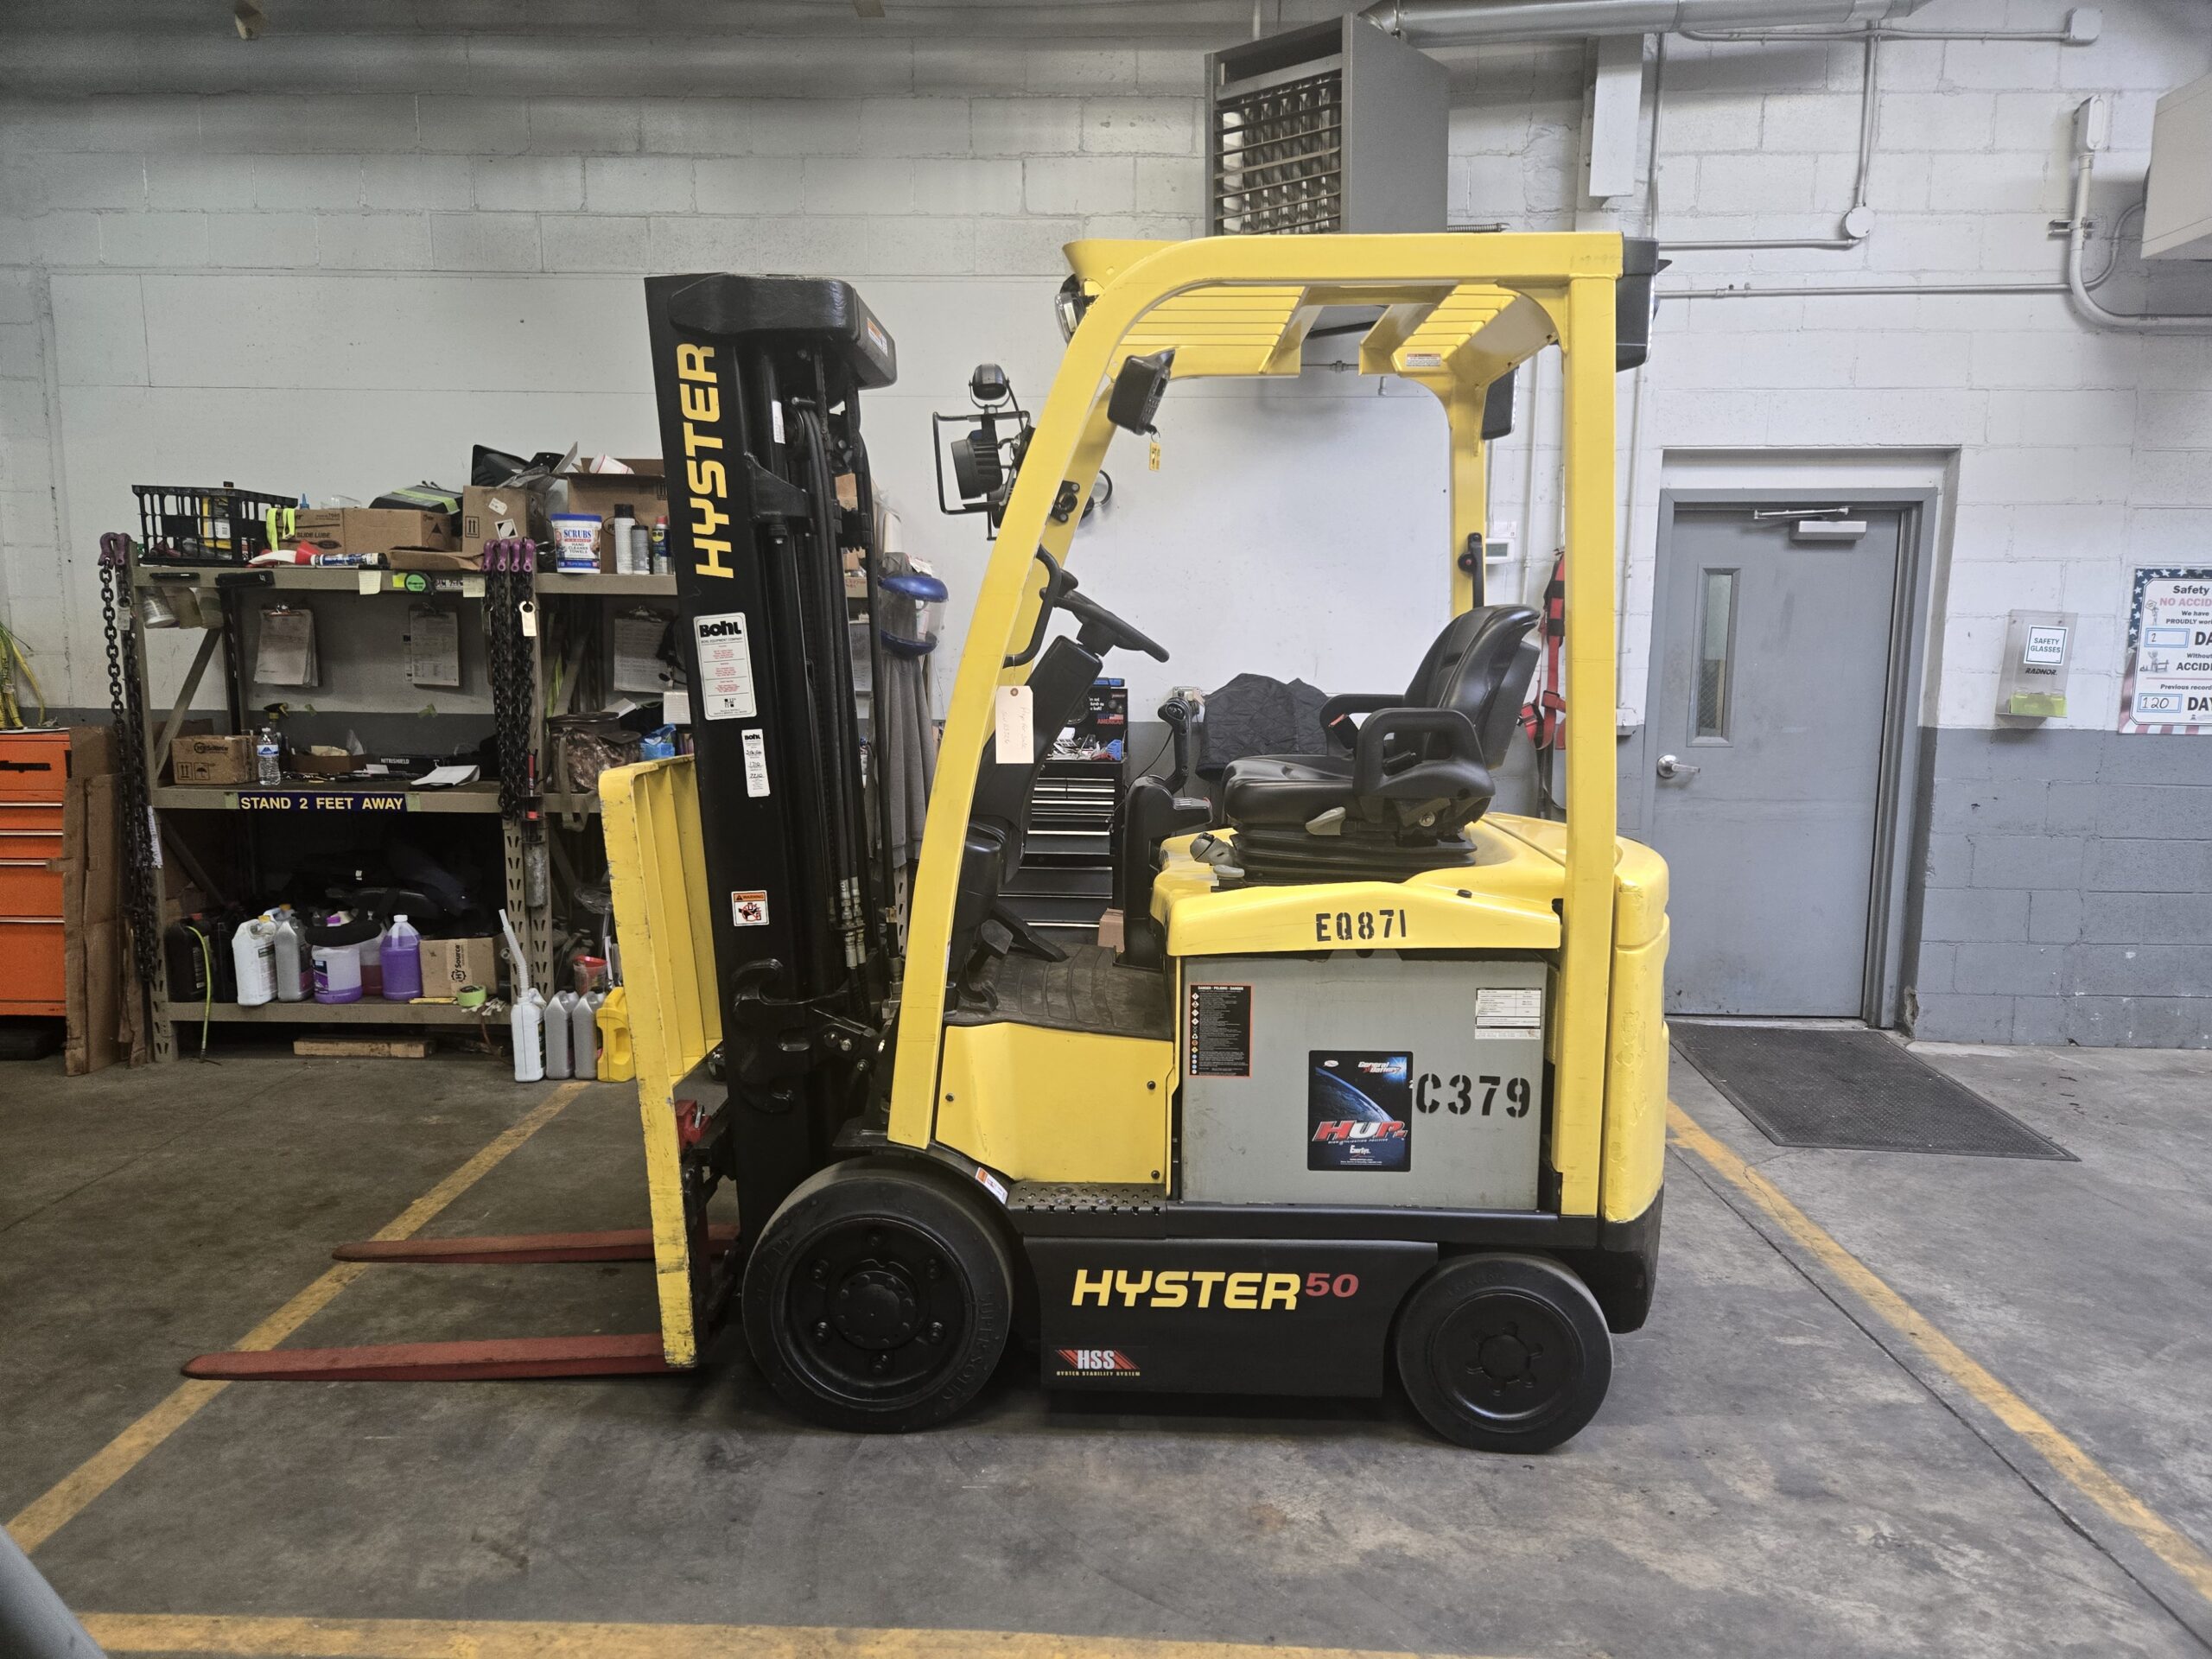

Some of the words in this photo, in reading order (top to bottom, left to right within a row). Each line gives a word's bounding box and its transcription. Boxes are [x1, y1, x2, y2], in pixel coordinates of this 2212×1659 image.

[677, 343, 734, 579] HYSTER
[563, 529, 592, 538] SCRUBS
[2172, 585, 2209, 596] Safety
[2159, 597, 2176, 607] NO
[2178, 598, 2212, 607] ACCID
[2195, 631, 2212, 645] DA
[2176, 662, 2212, 671] ACCID
[2142, 696, 2170, 709] 120
[241, 797, 291, 810] STAND
[299, 797, 308, 810] 2
[316, 797, 353, 810] FEET
[361, 797, 404, 810] AWAY
[1315, 909, 1407, 942] EQ871
[1415, 1072, 1532, 1118] C379
[1071, 1268, 1300, 1310] HYSTER
[1305, 1272, 1359, 1298] 50
[1077, 1350, 1116, 1370] HSS
